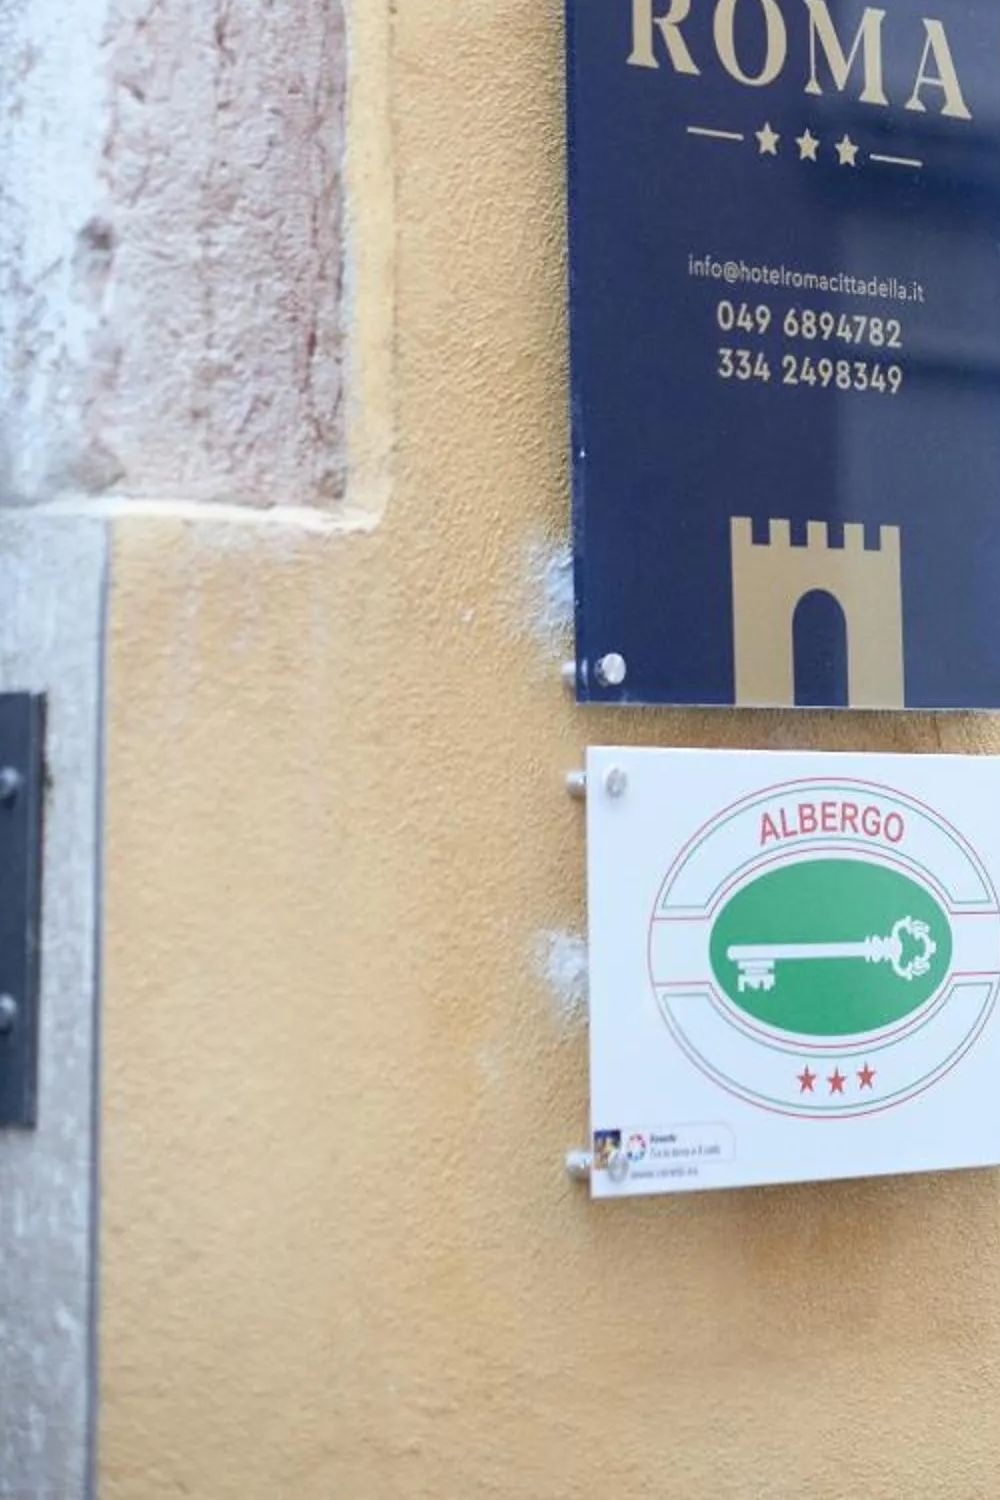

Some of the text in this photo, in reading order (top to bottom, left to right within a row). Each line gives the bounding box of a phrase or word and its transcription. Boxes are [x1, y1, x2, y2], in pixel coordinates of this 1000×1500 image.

[688, 254, 925, 303] info@hotelromacittadella.it
[717, 300, 902, 348] 049 6894782
[718, 348, 902, 393] 334 2498349
[759, 801, 905, 846] ALBERGO
